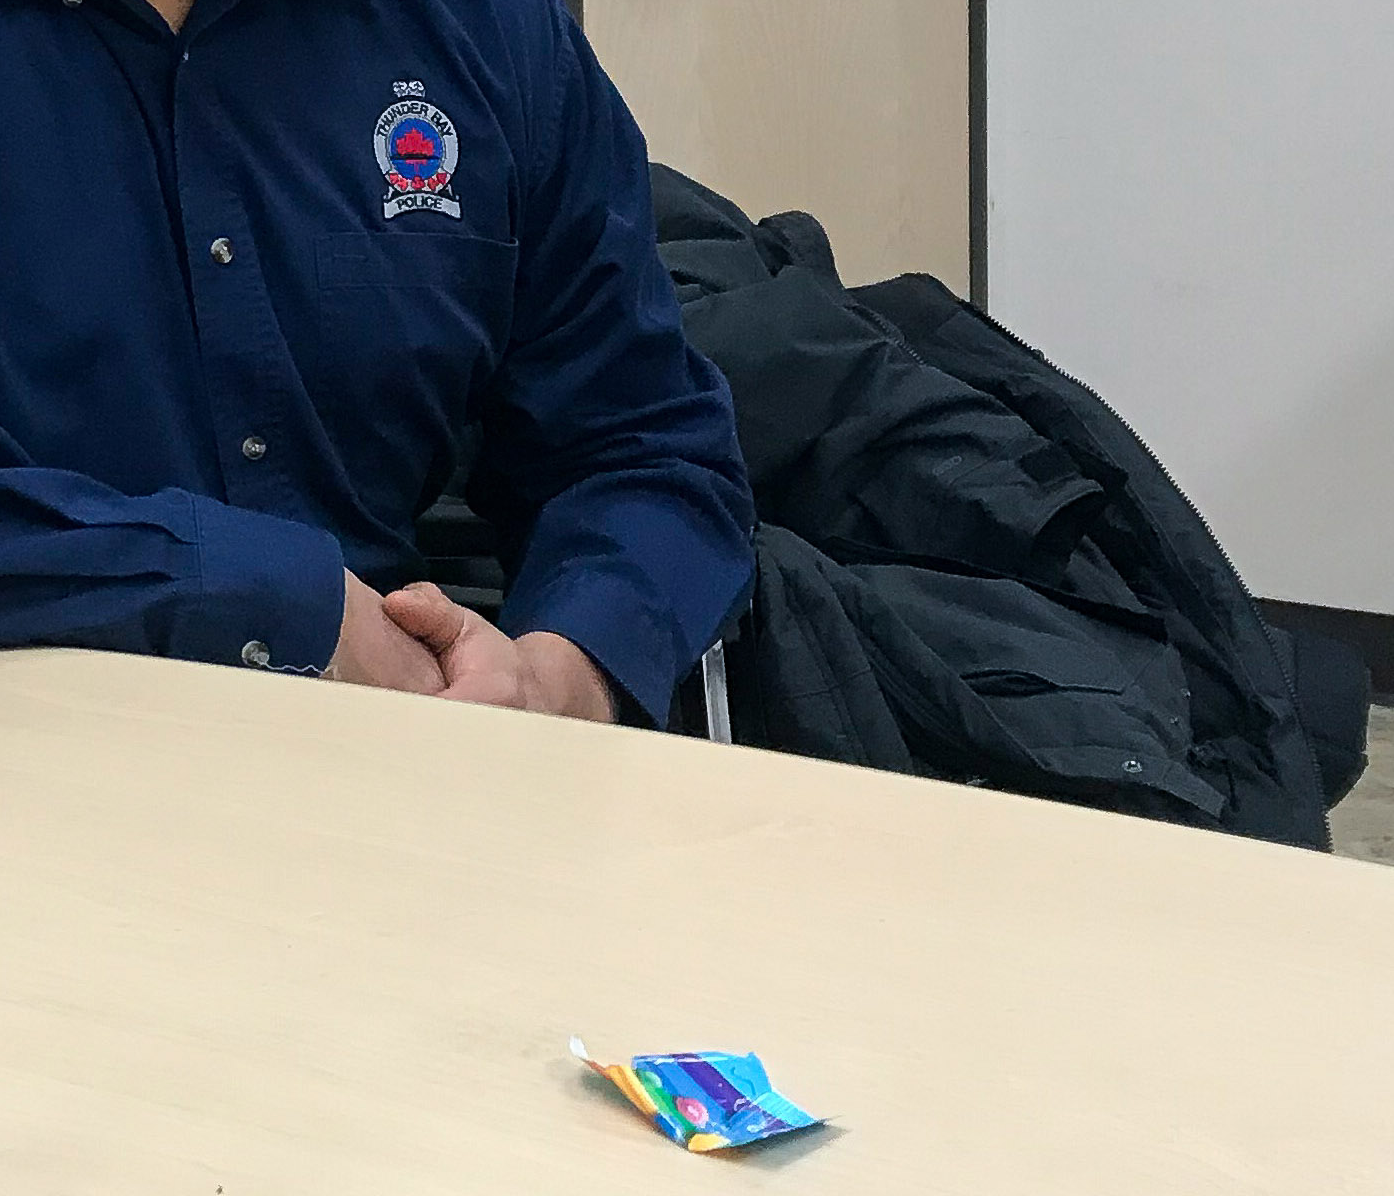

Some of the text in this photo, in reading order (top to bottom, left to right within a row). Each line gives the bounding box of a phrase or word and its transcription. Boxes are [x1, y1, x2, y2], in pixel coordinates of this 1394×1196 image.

[376, 103, 454, 137] THUNDER BAY
[395, 196, 443, 210] POLICE
